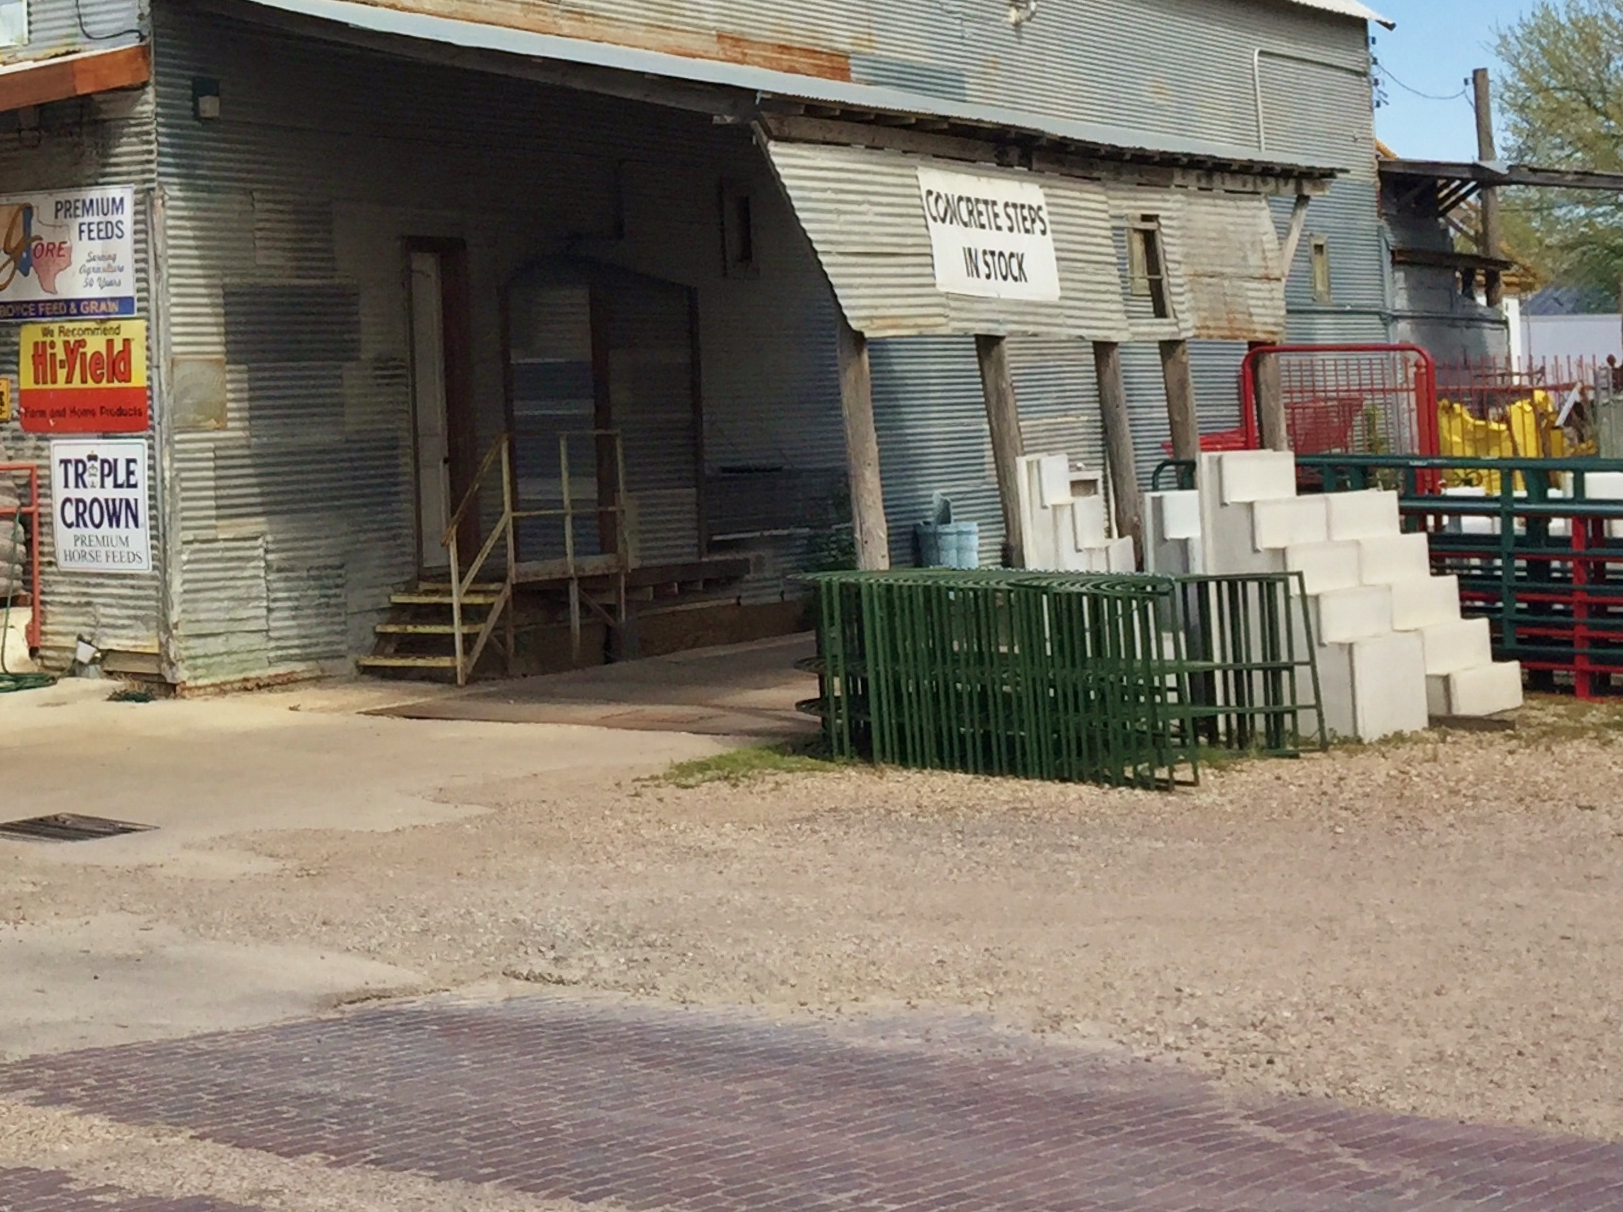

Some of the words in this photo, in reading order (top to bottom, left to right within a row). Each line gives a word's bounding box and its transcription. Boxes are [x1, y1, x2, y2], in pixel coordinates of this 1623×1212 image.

[54, 196, 125, 220] PREMIUM
[926, 189, 1003, 232] CONCRETE
[1003, 200, 1048, 236] STEPS
[78, 220, 125, 242] FEEDS
[962, 246, 981, 279] IN
[981, 249, 1029, 284] STOCK
[38, 303, 67, 316] FEED
[69, 302, 77, 314] &
[80, 300, 120, 314] GRAIN
[41, 326, 55, 338] We
[58, 324, 122, 338] Recommend
[32, 338, 132, 386] Hi-Yield
[24, 406, 47, 419] Farm
[48, 406, 67, 419] and
[69, 405, 97, 419] Home
[100, 405, 143, 418] Products
[60, 497, 140, 529] CROWN
[73, 534, 130, 548] PREMIUM
[64, 549, 103, 563] HORSE
[105, 550, 143, 564] FEEDS
